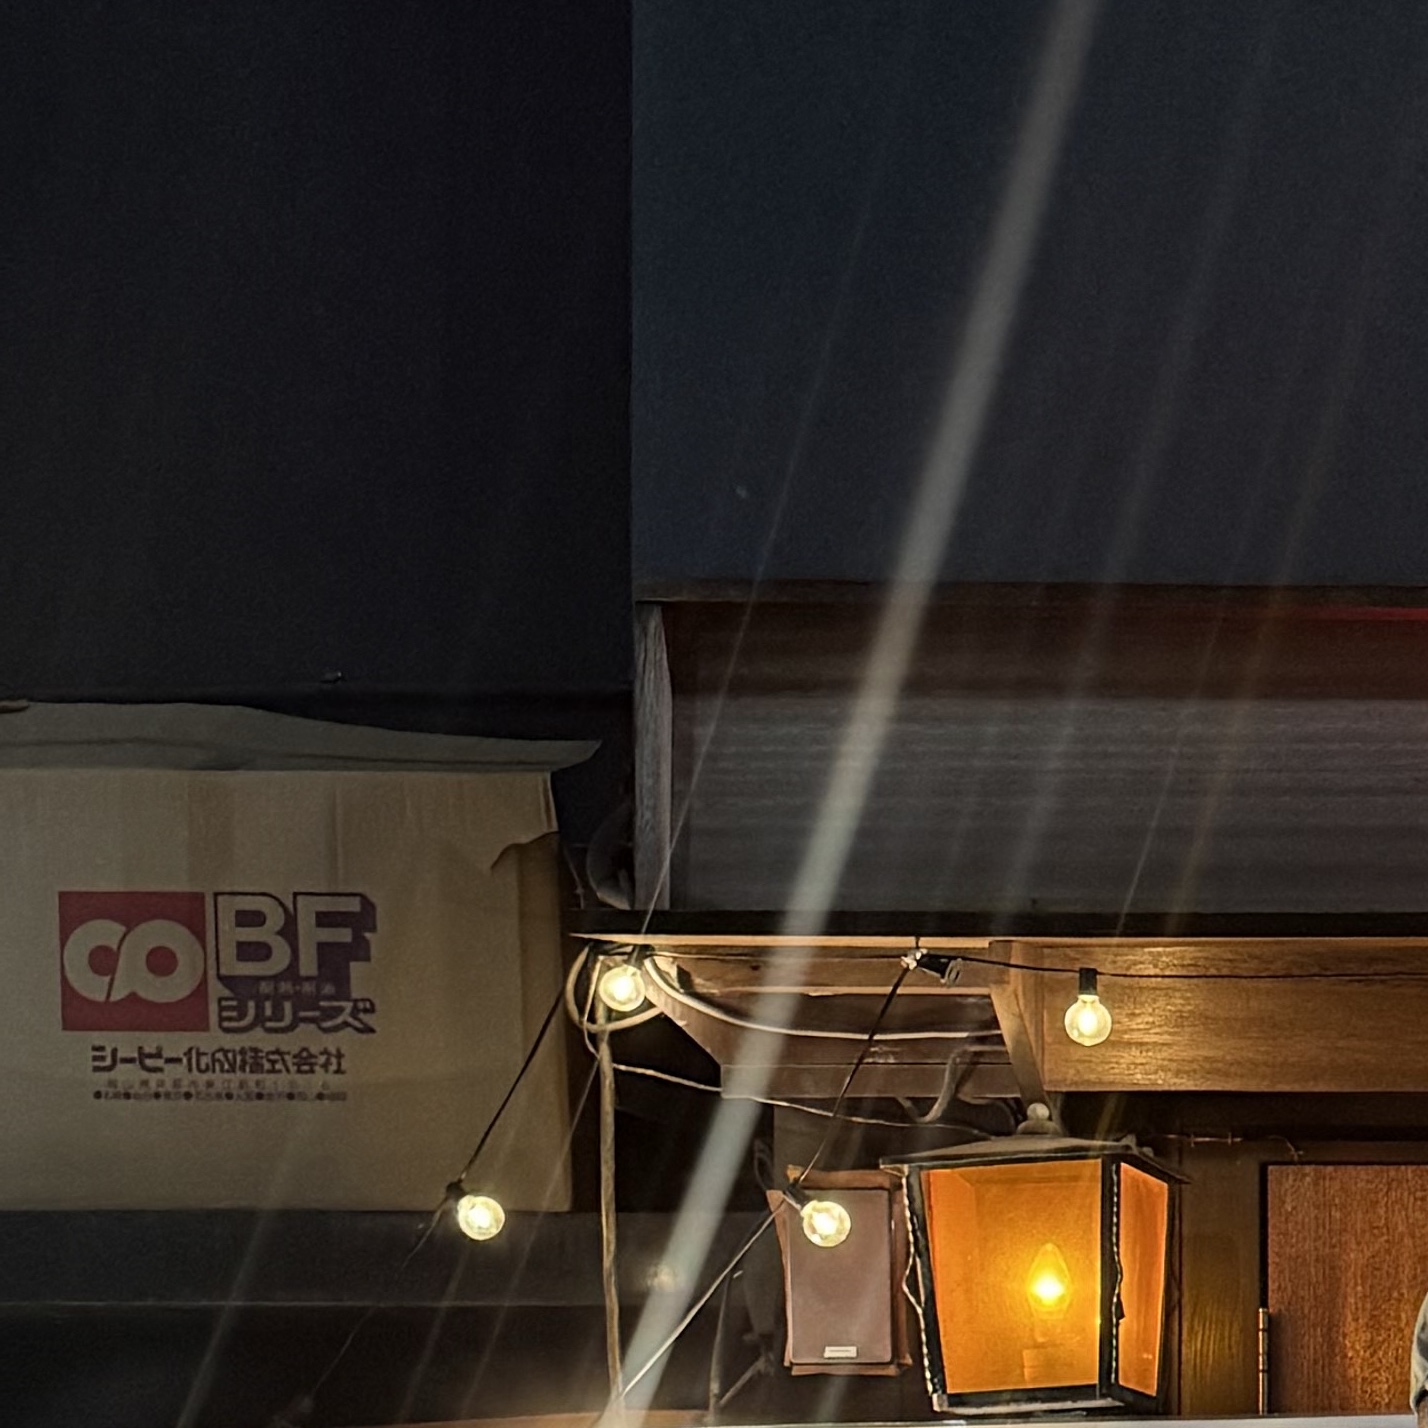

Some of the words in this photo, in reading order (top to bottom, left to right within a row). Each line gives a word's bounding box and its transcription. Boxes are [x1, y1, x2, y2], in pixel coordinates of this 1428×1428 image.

[213, 892, 376, 981] BF
[218, 997, 376, 1033] シリーズ
